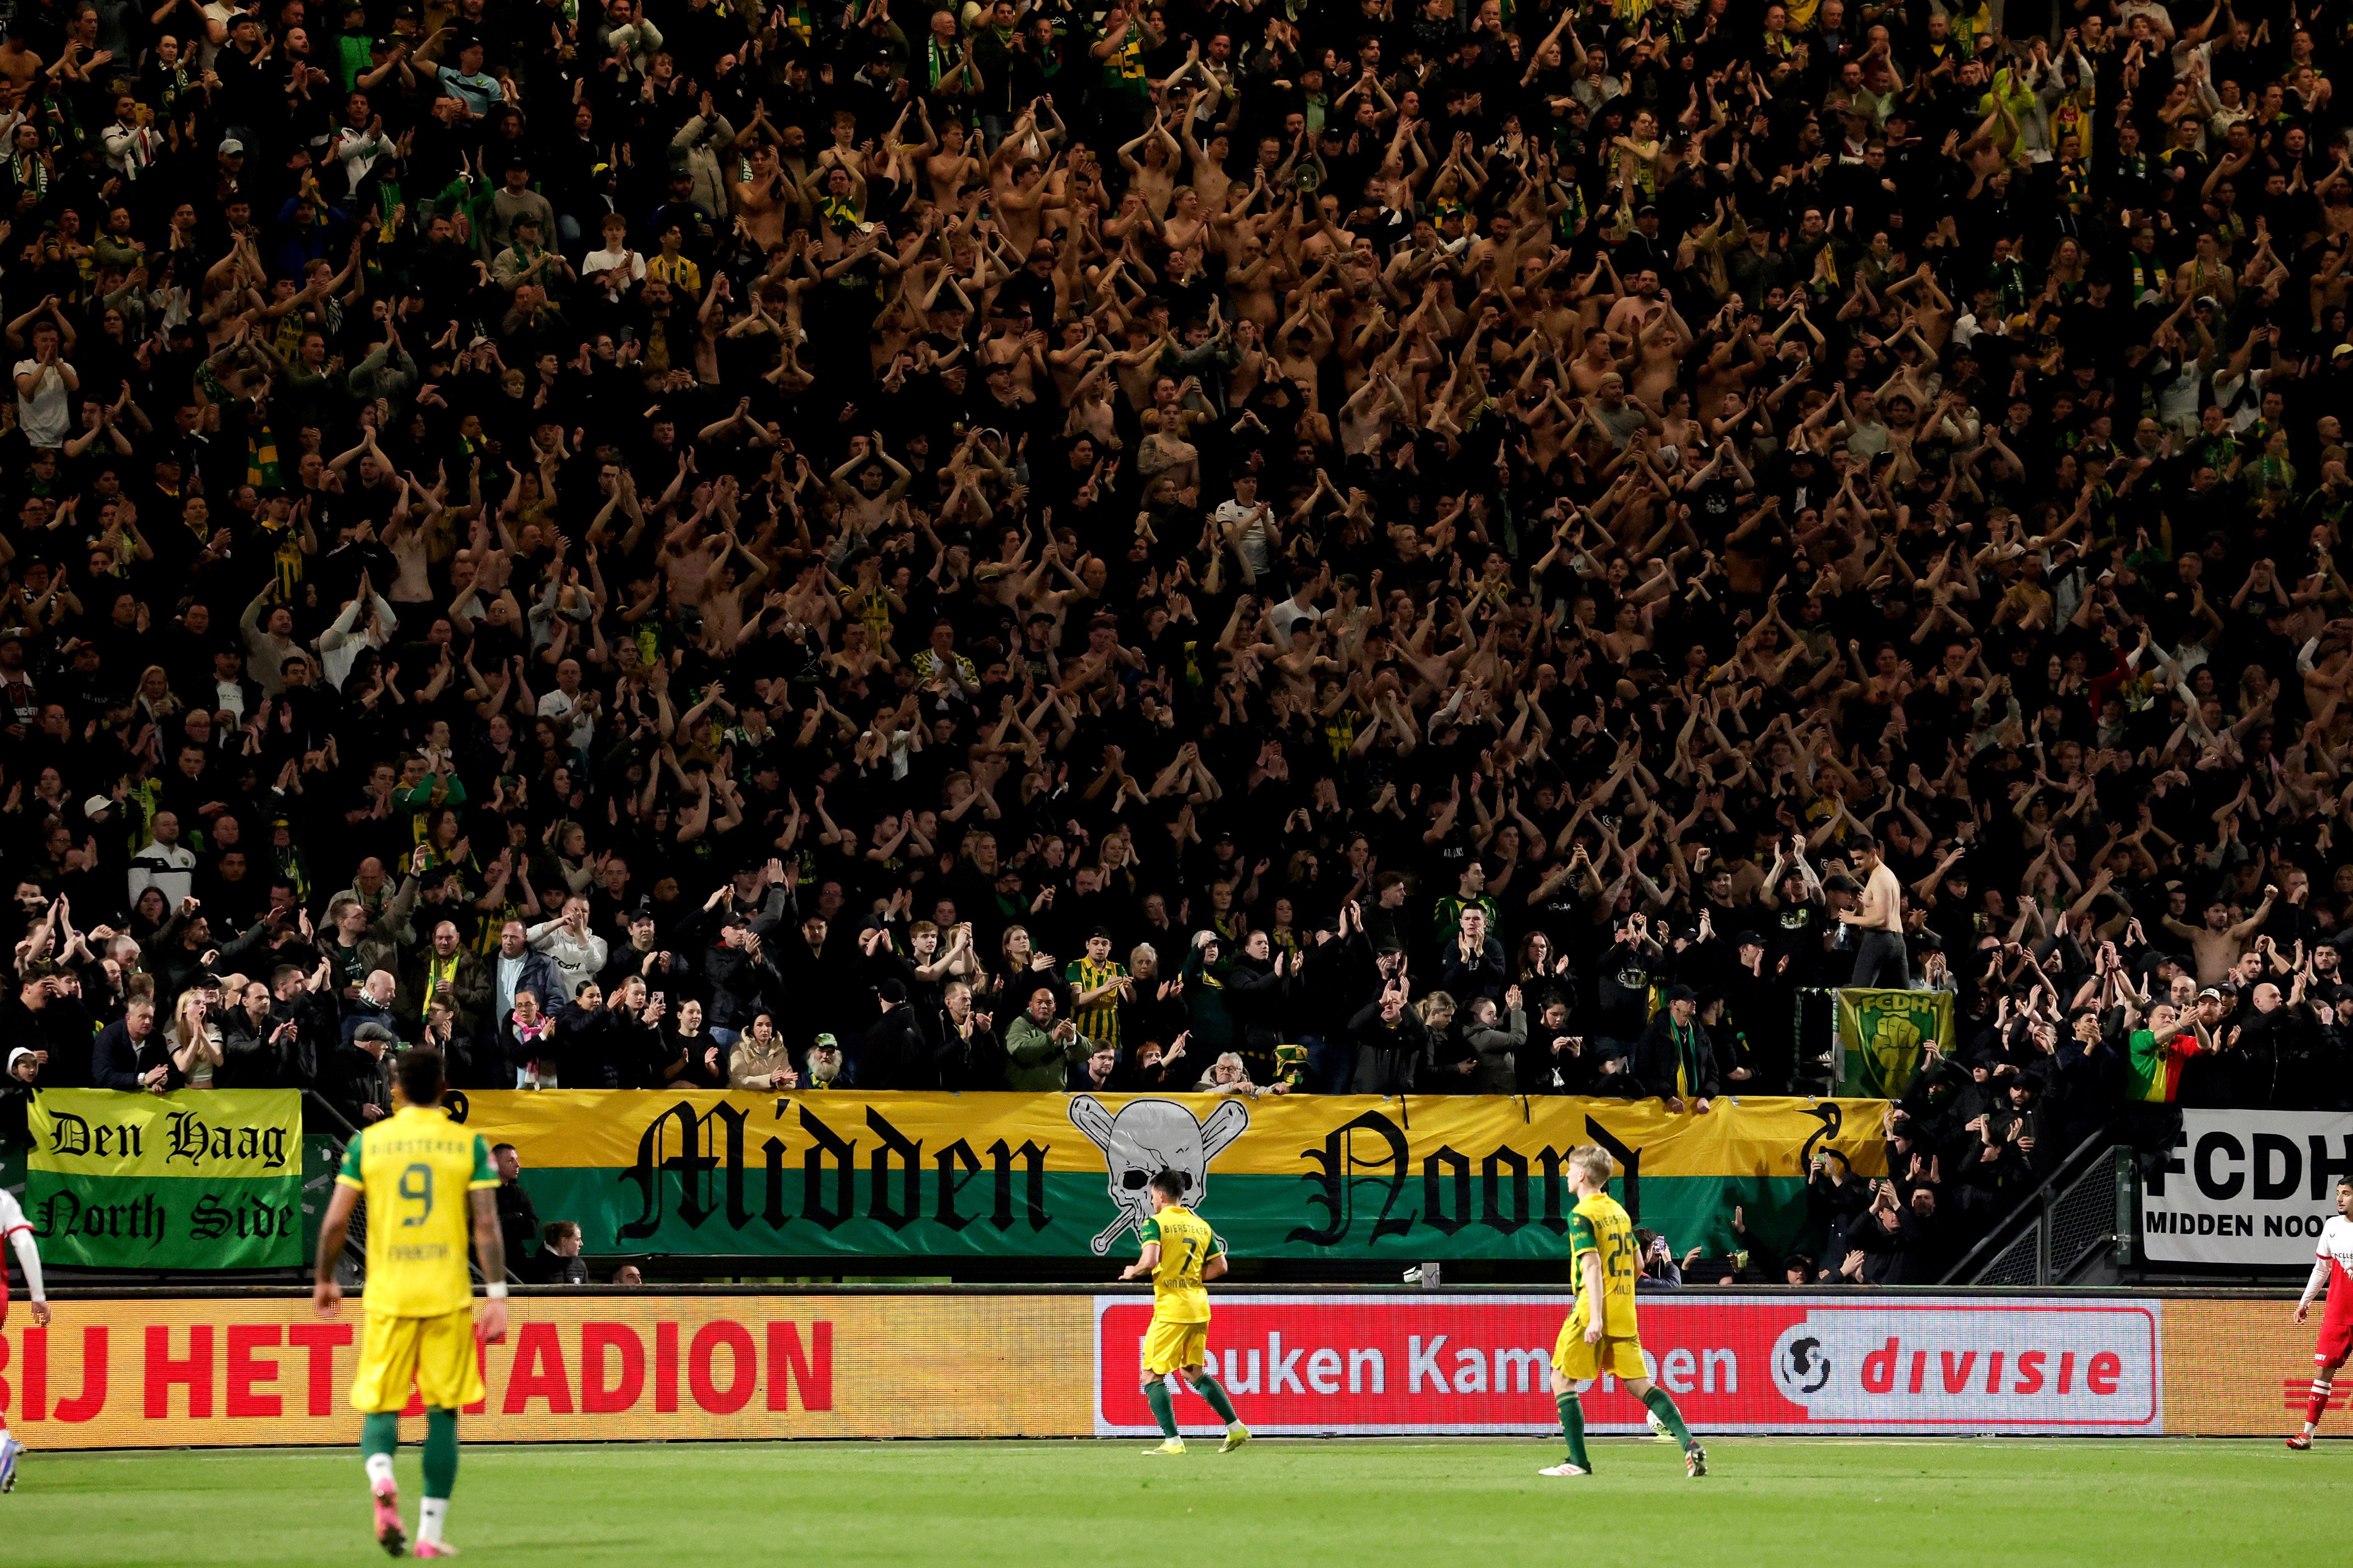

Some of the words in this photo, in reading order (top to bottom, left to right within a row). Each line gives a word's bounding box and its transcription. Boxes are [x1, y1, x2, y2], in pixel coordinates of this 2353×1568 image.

[1861, 993, 1932, 1014] FCDH
[49, 1109, 143, 1158] Den
[165, 1110, 287, 1169] Haag
[398, 1163, 434, 1227] 9
[616, 1098, 1053, 1245] Midden
[1284, 1109, 1642, 1247] Noord
[33, 1189, 165, 1249] North
[190, 1192, 293, 1239] Side
[1164, 1225, 1209, 1236] BIERSTEKER
[2146, 1210, 2254, 1237] MIDDEN
[2264, 1215, 2340, 1237] NOO
[1181, 1237, 1198, 1275] 7
[143, 1324, 354, 1419] HET
[399, 1319, 833, 1416] TADION
[1408, 1335, 1738, 1394] Kamen
[1861, 1337, 2121, 1395] divisie
